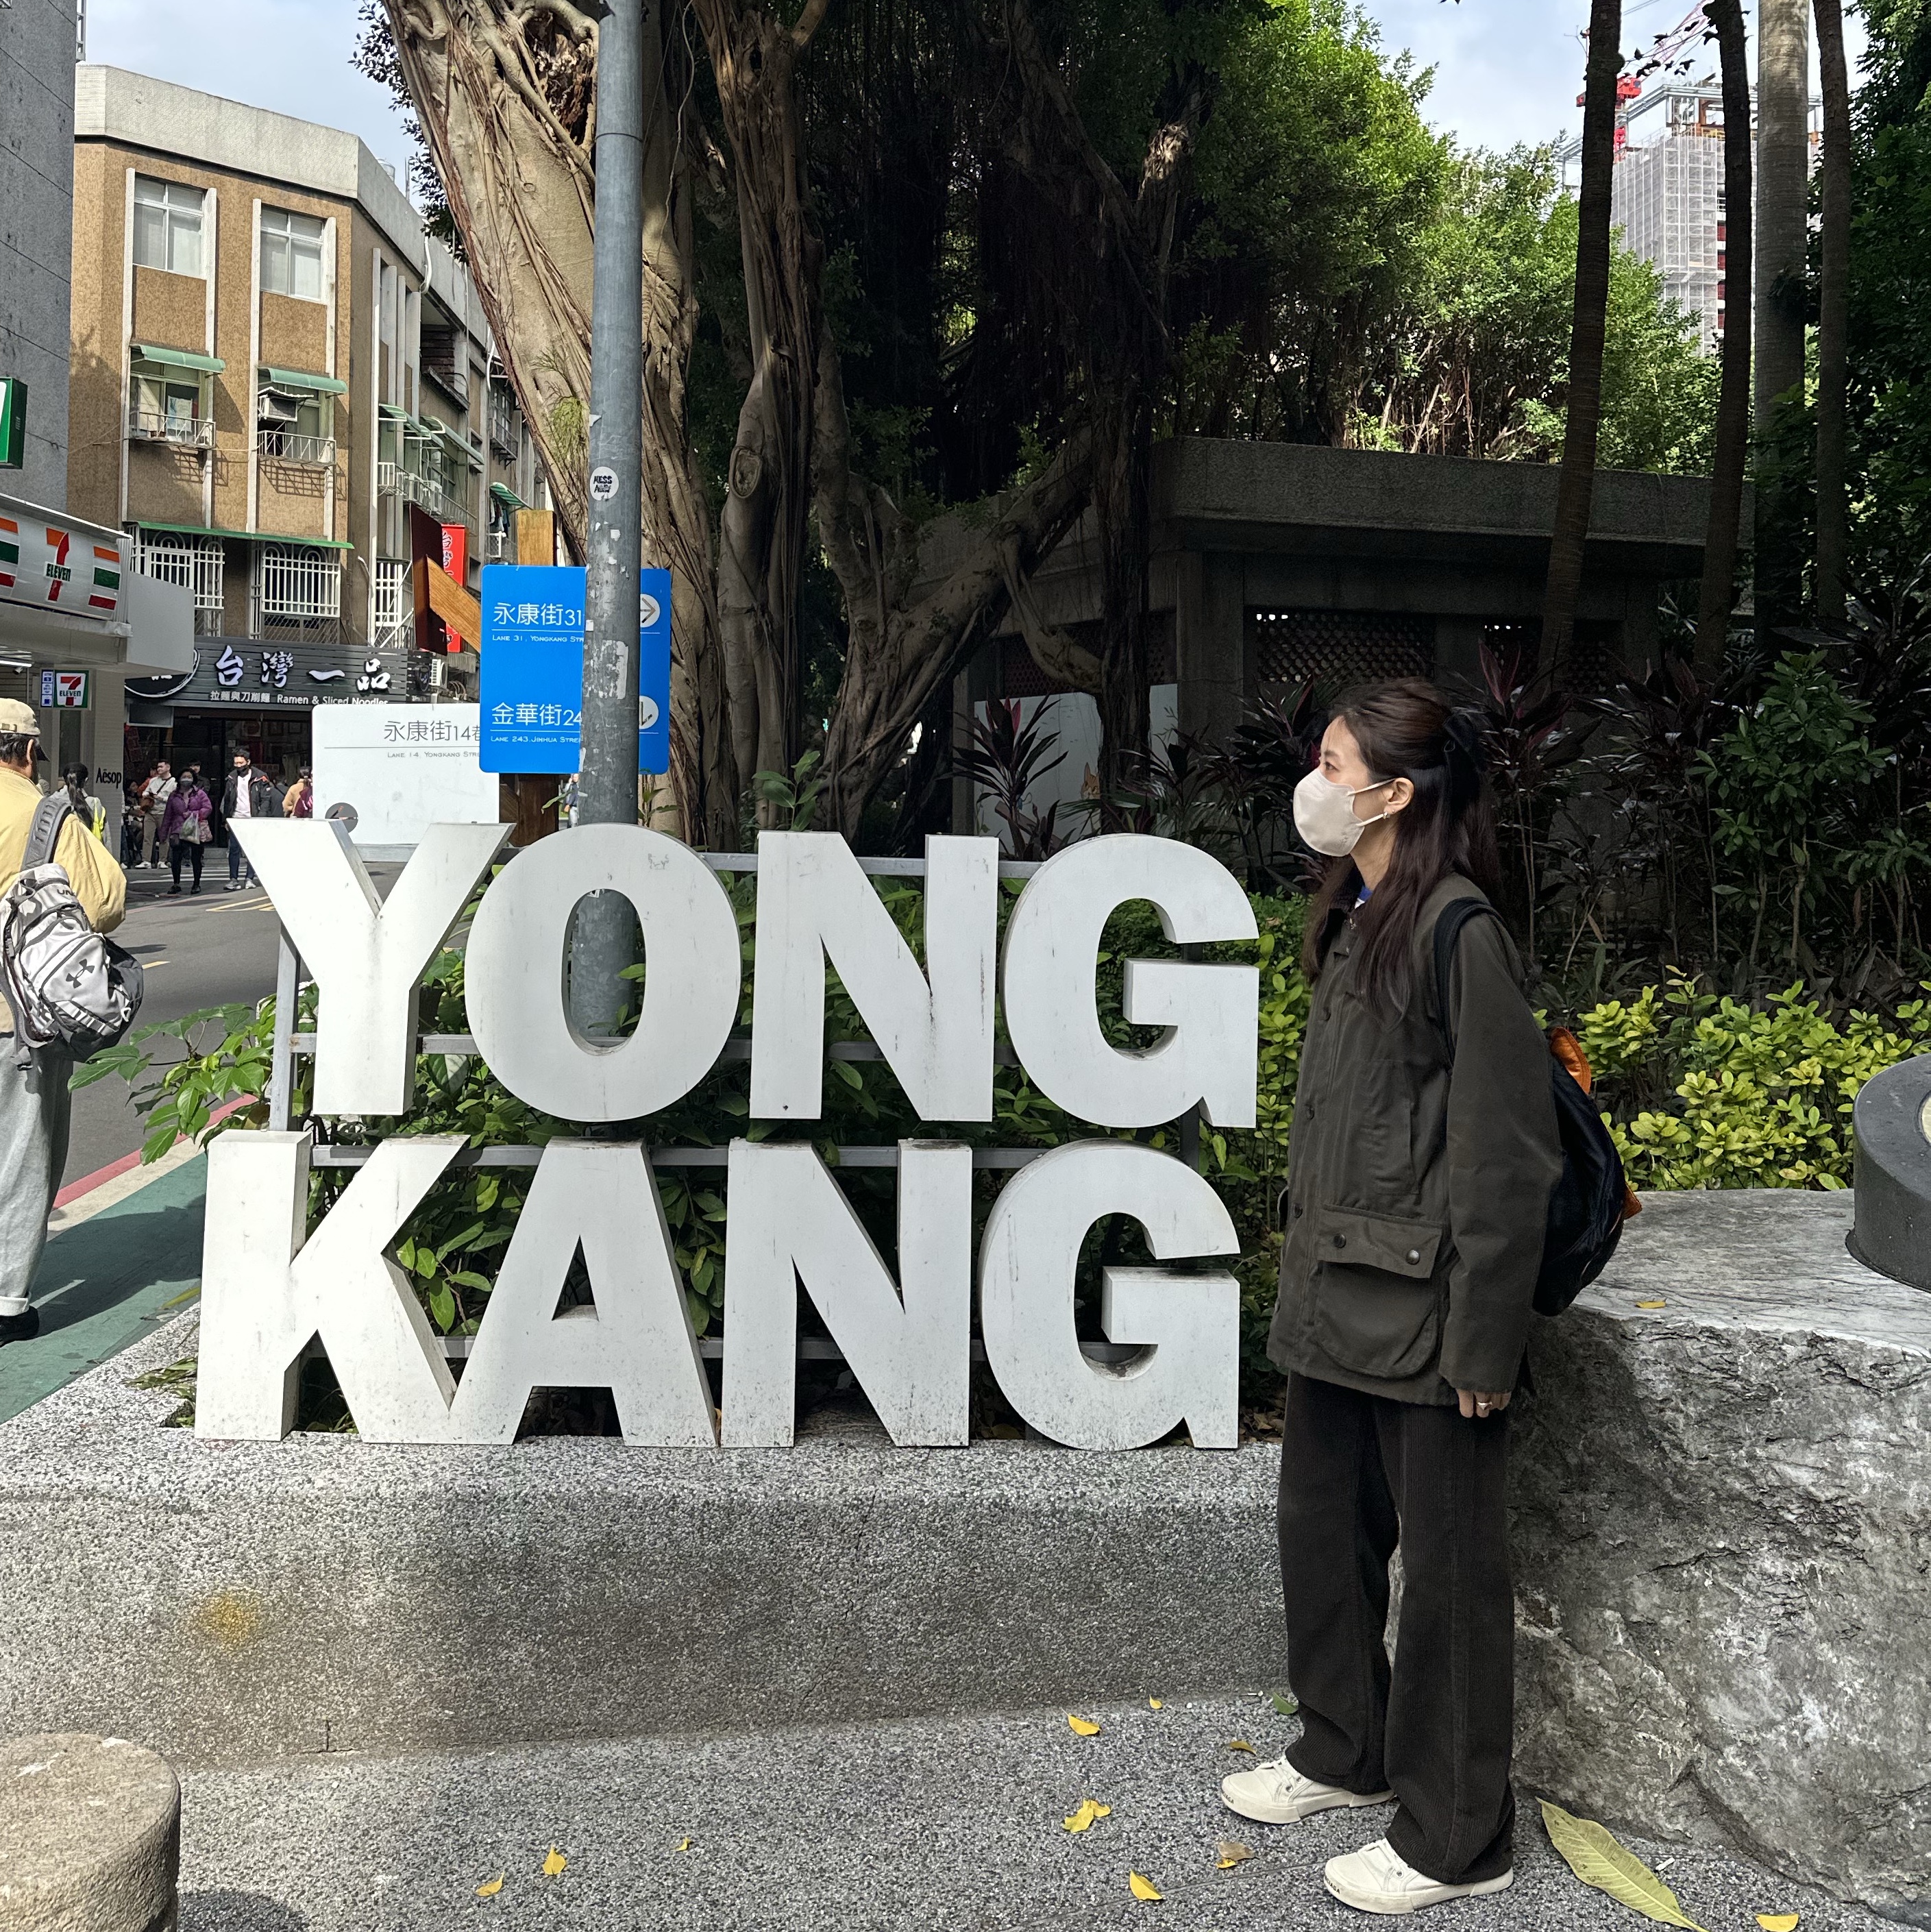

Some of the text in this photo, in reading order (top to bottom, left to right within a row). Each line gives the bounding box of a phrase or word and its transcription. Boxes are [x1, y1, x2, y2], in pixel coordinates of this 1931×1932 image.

[493, 602, 582, 626] 永康街31
[215, 645, 391, 692] 台灣一品
[277, 694, 308, 705] Ramen
[312, 696, 319, 705] &
[322, 696, 349, 705] Sliced
[227, 822, 1260, 1129] YONG
[195, 1129, 1240, 1452] KANG
